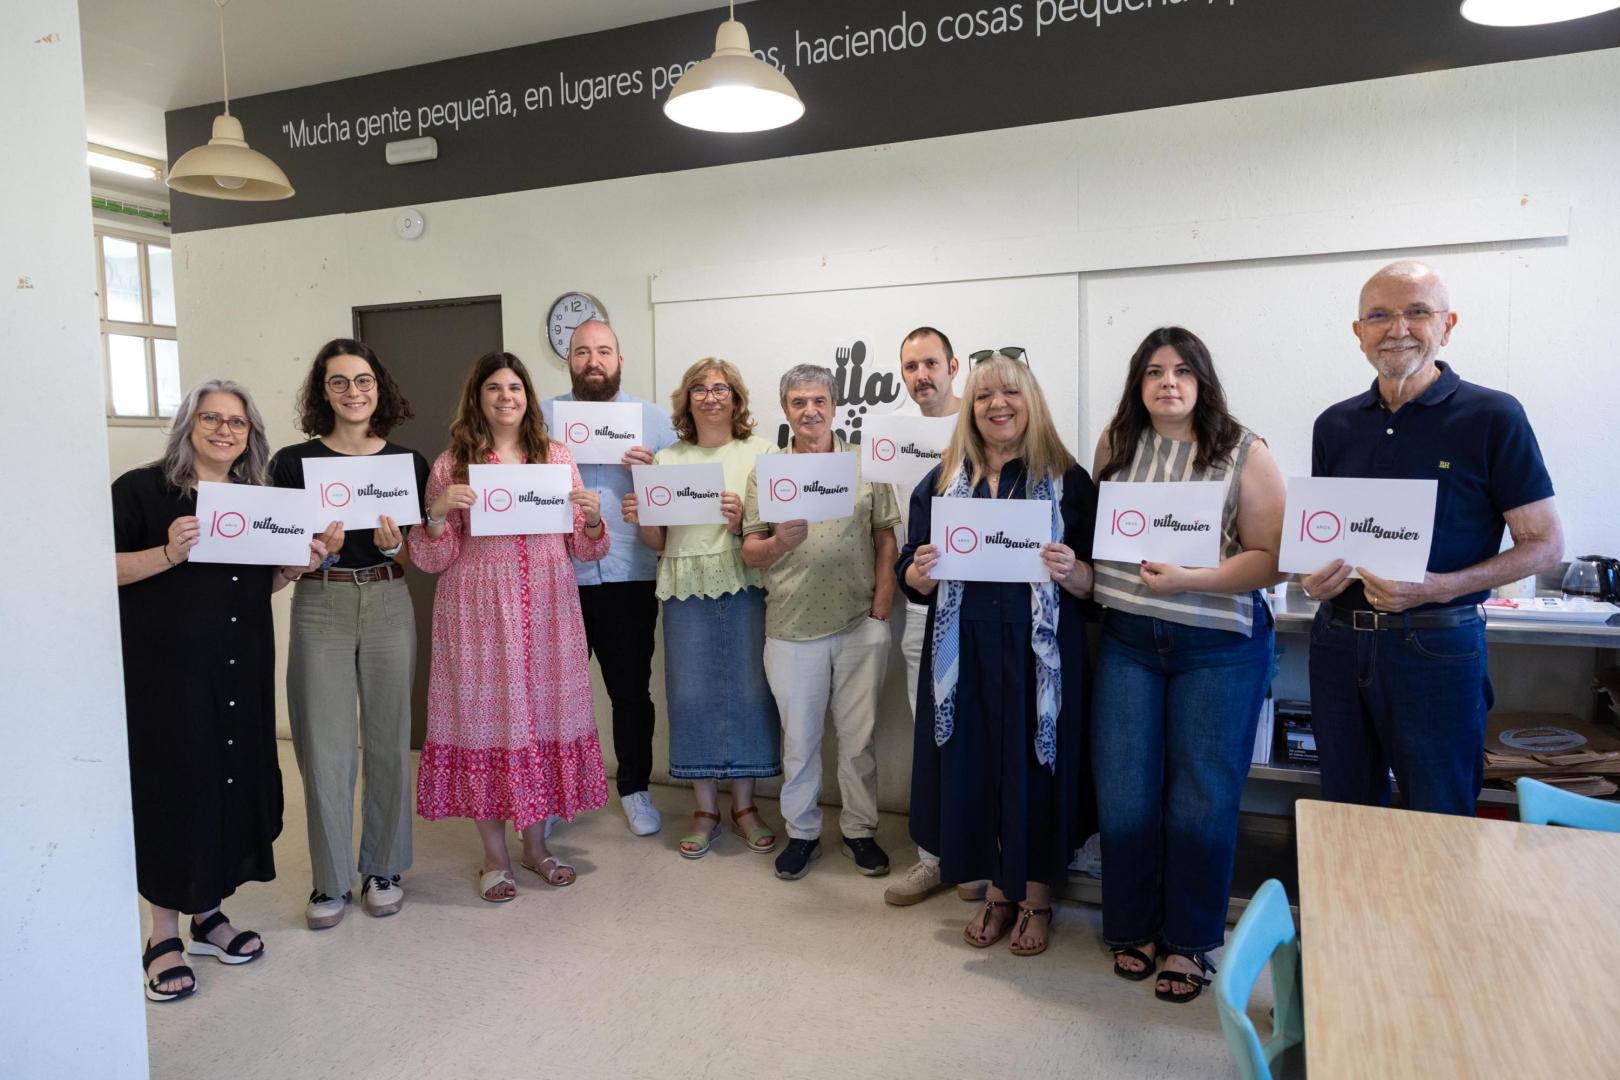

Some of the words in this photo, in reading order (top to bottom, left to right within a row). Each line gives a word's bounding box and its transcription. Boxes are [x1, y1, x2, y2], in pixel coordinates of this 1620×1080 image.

[282, 112, 351, 149] "Mucha
[356, 107, 412, 146] gente
[418, 89, 517, 137] pequeña,
[525, 86, 553, 111] en
[560, 71, 644, 111] lugares
[796, 10, 927, 67] haciendo
[937, 3, 1024, 43] cosas
[571, 301, 583, 312] 12
[554, 324, 562, 335] 9
